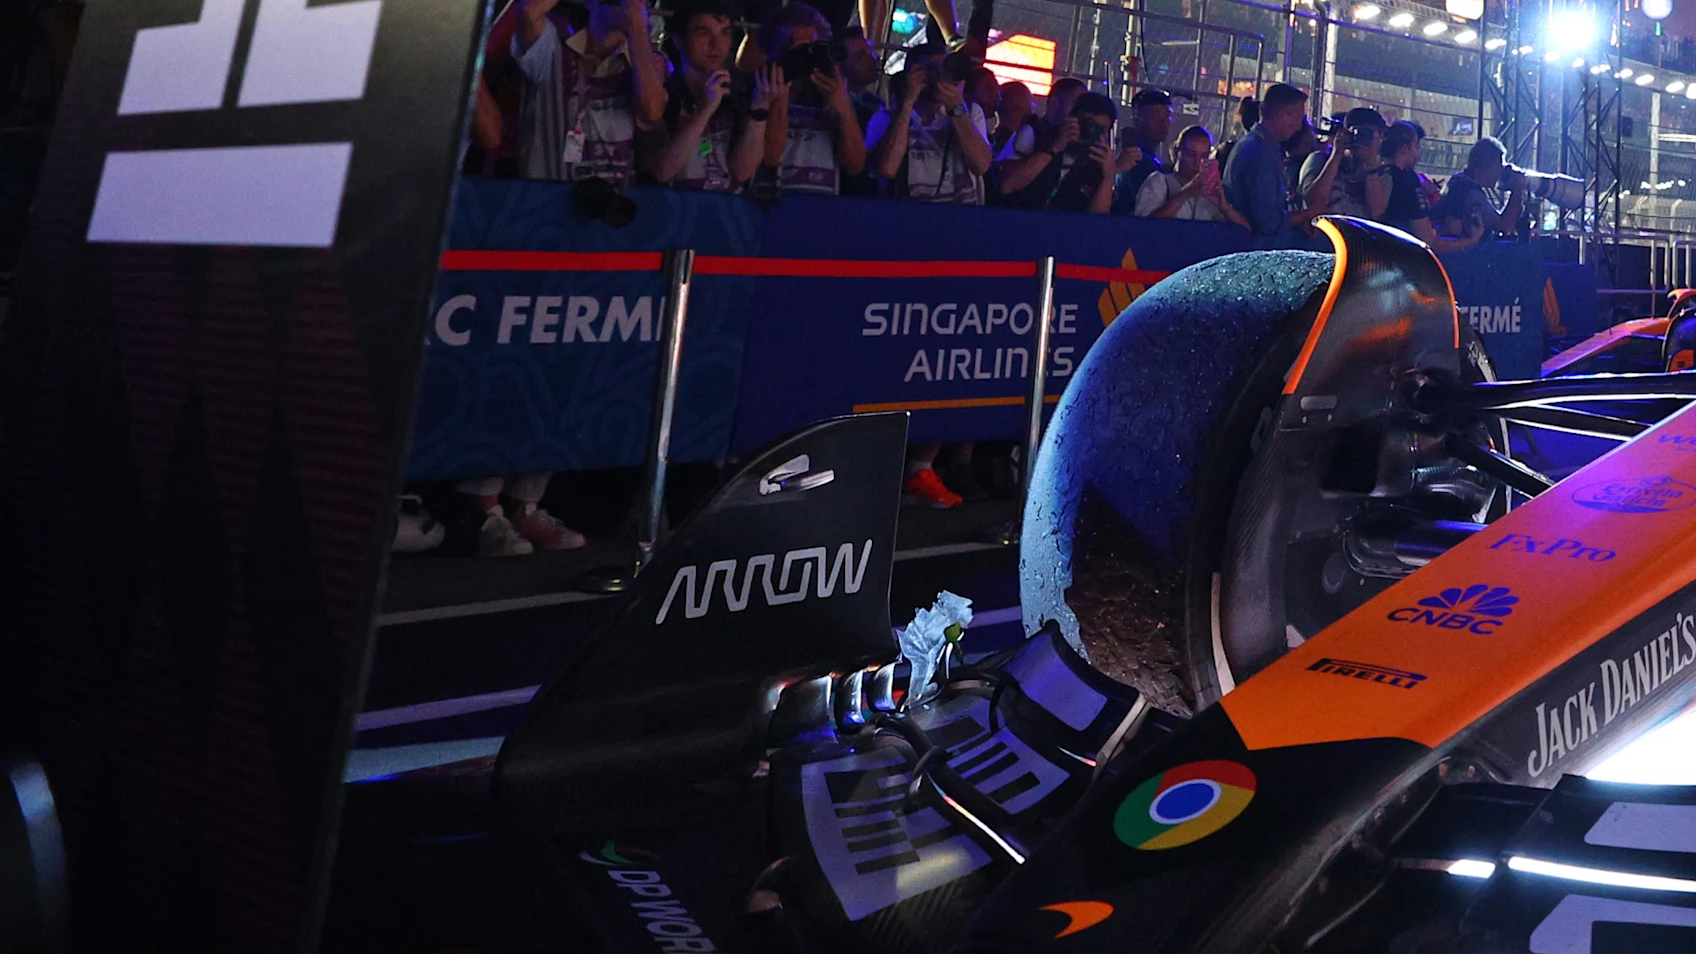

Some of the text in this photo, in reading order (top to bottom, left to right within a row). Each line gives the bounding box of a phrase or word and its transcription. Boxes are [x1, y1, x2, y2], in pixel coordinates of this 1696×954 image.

[496, 296, 667, 344] FERM
[904, 346, 1074, 382] AIRLINS
[1487, 533, 1617, 562] FxPro
[655, 538, 873, 625] ARROW
[1387, 606, 1505, 636] CNBC
[1305, 657, 1428, 690] PIRELLI
[1527, 687, 1600, 778] JACK
[607, 870, 716, 954] DP WOR
